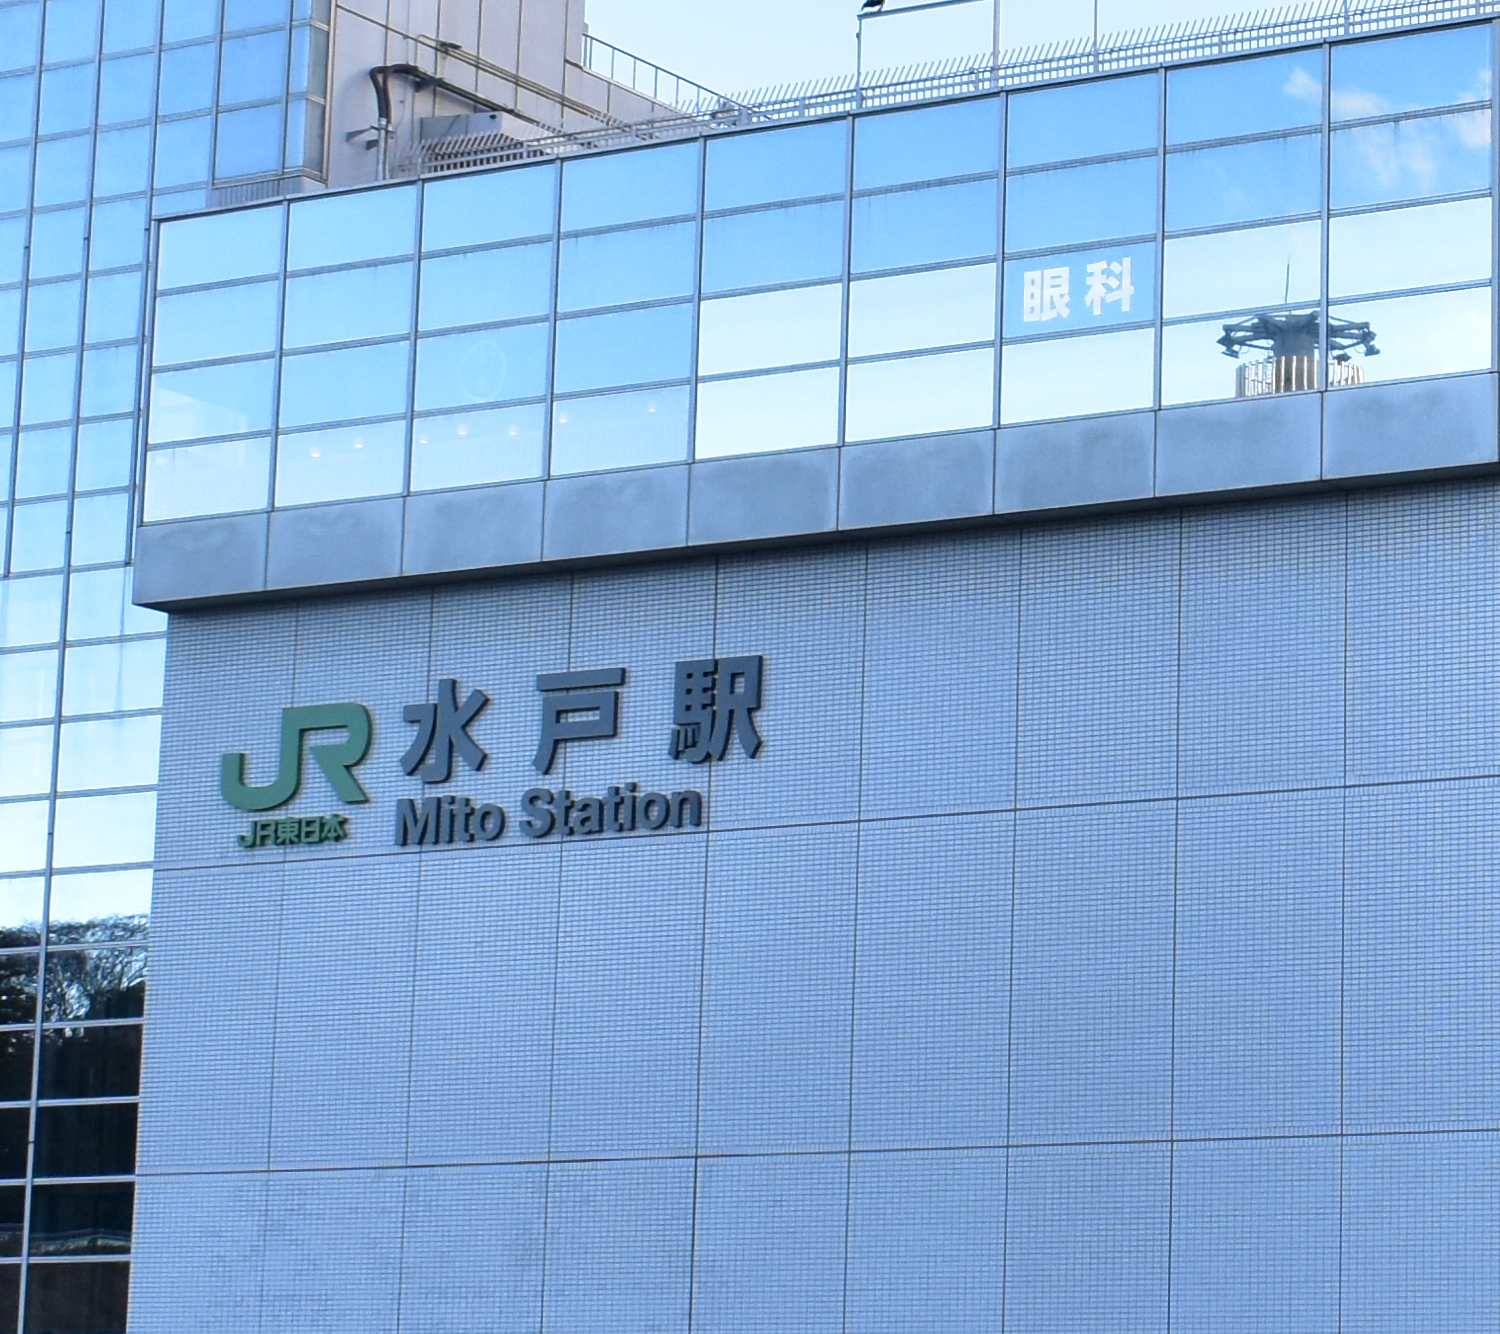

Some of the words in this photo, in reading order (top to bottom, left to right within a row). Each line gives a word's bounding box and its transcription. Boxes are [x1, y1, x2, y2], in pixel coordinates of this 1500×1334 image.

[1022, 257, 1134, 323] 眼科
[401, 654, 764, 783] 水戸駅
[221, 702, 373, 810] JR
[238, 815, 348, 848] JR東日本
[396, 795, 506, 846] Mito
[518, 782, 703, 838] Station
